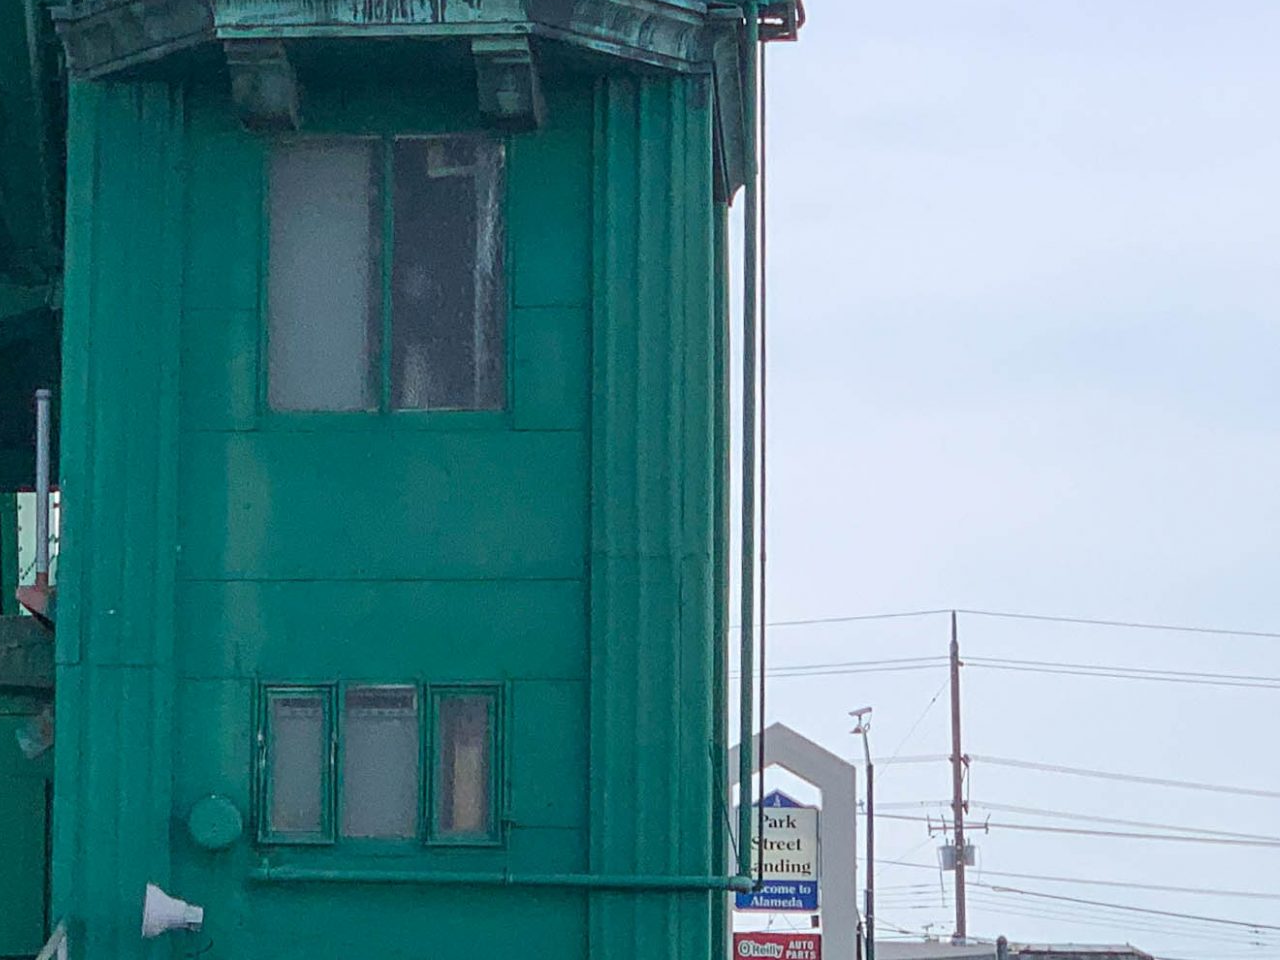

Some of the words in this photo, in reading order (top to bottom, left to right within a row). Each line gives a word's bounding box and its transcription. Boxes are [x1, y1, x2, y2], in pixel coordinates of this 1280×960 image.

[751, 836, 801, 850] Street
[751, 859, 811, 876] anding
[799, 885, 811, 894] to
[750, 896, 803, 908] Alameda
[739, 941, 783, 957] O'Reilly
[789, 941, 814, 949] AUTO
[786, 950, 816, 959] PARTS
